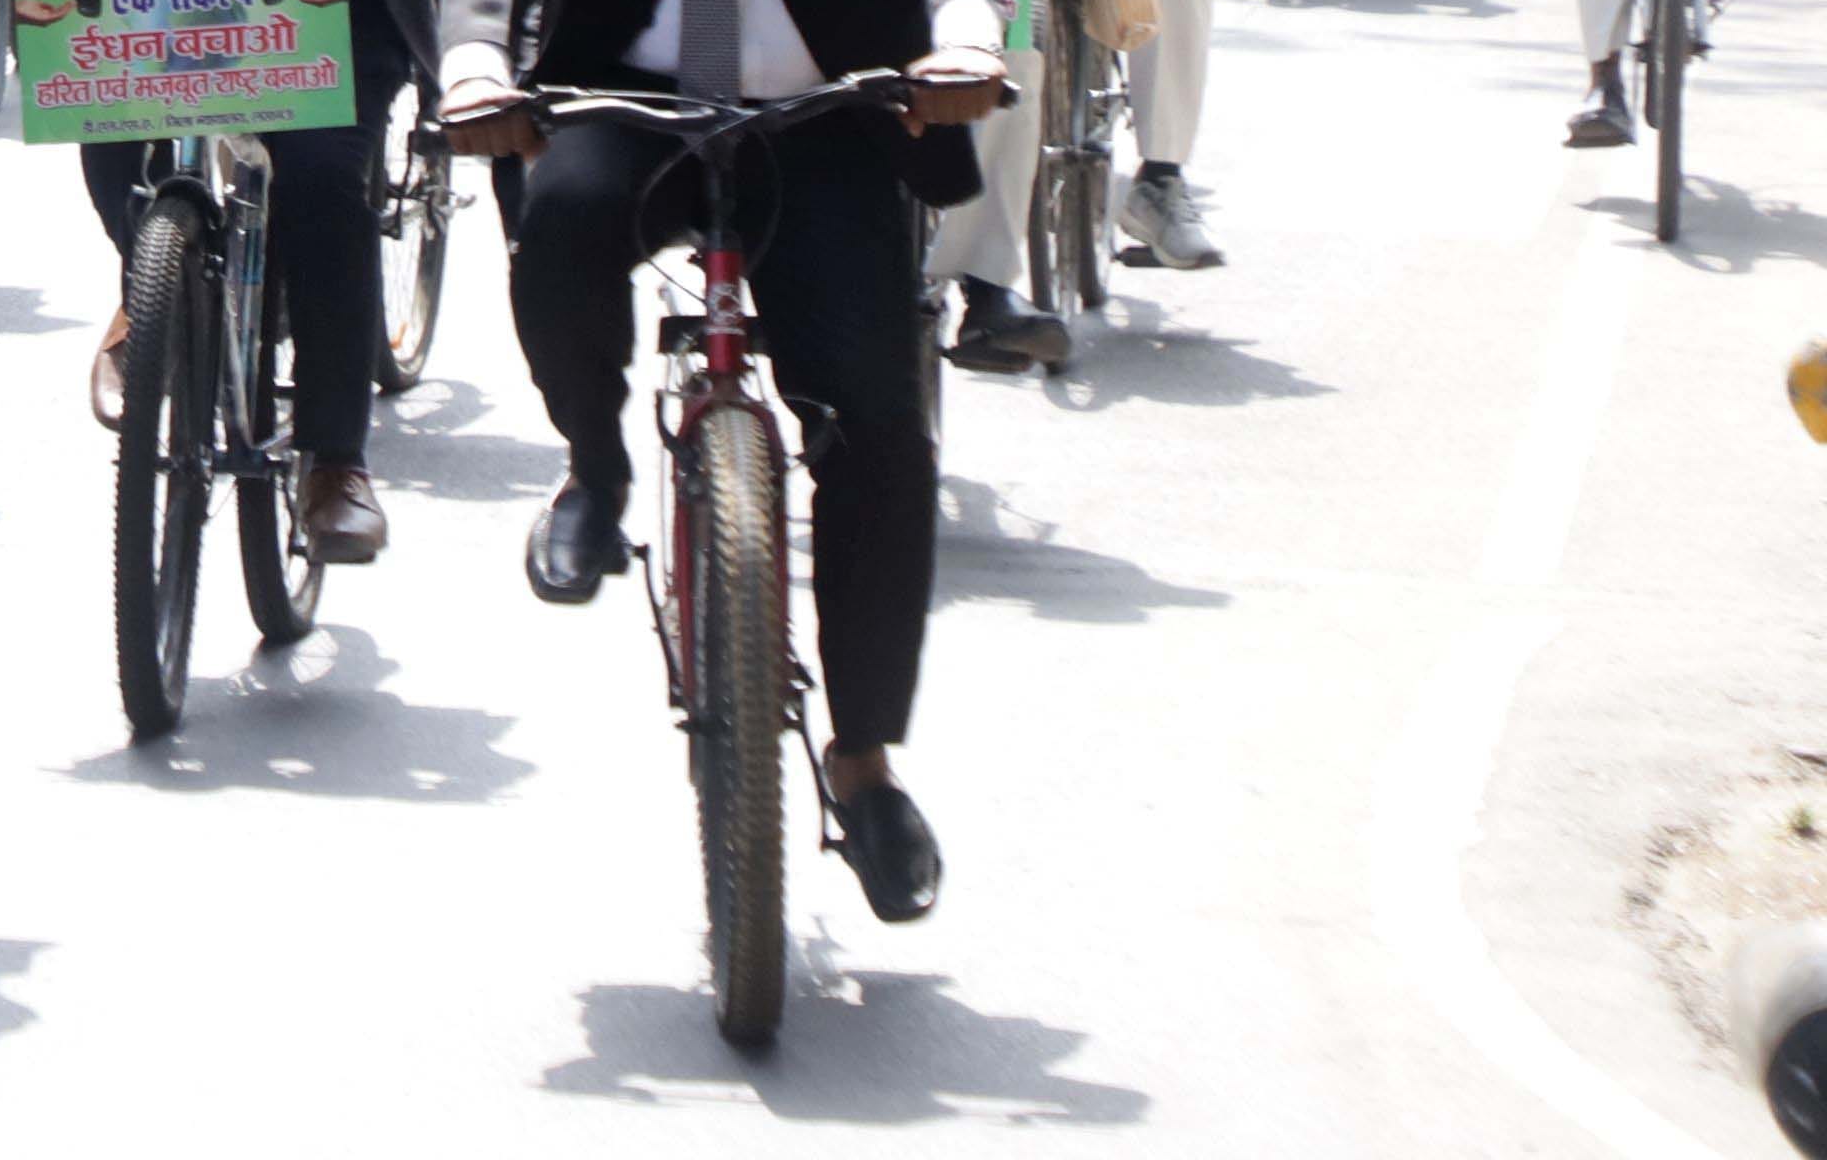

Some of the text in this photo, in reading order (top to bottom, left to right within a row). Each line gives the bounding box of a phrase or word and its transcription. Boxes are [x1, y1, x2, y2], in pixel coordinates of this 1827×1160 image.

[174, 14, 295, 59] बचाओ
[36, 74, 91, 108] हरित
[96, 70, 128, 105] एवं
[215, 69, 260, 98] राष्ट्र
[264, 57, 337, 89] बनाओ
